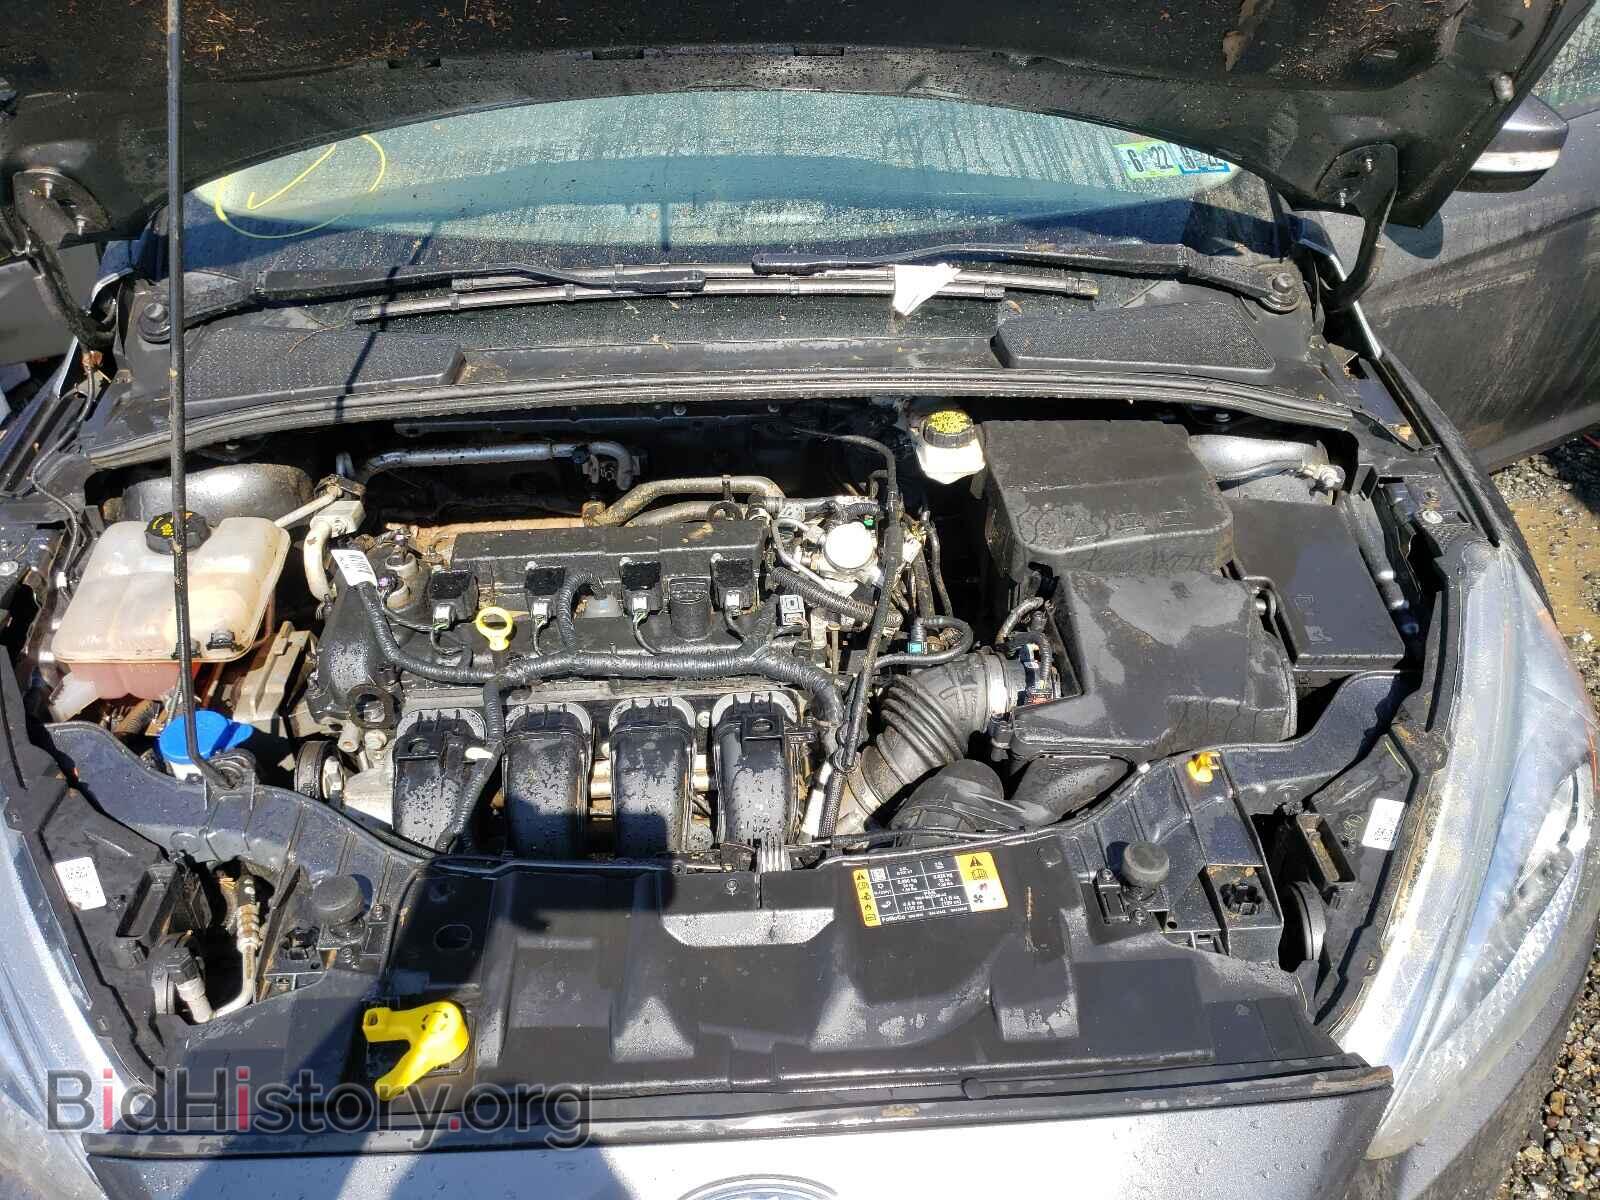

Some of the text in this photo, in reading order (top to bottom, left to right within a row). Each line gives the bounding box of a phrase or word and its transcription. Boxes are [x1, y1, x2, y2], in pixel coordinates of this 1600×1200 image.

[1127, 146, 1174, 172] 6 22
[1180, 145, 1196, 169] 6
